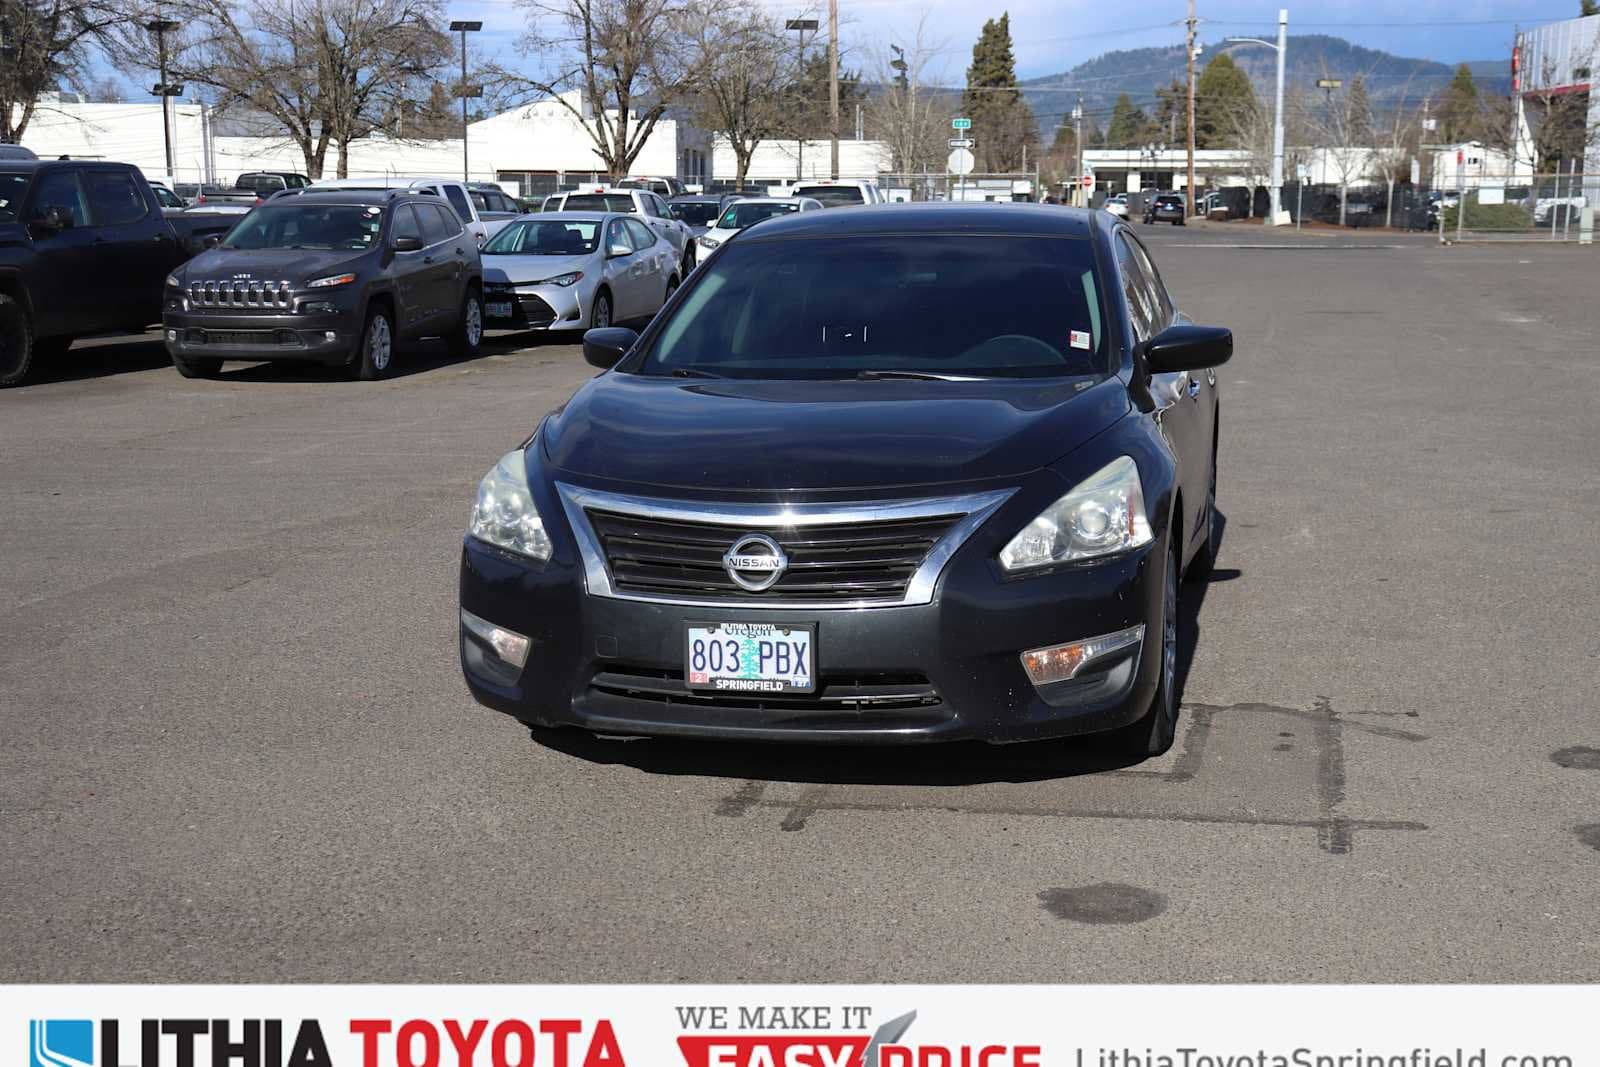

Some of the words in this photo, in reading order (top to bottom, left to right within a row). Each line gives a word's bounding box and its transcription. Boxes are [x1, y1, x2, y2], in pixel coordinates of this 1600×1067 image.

[728, 557, 780, 568] NISSAN
[748, 623, 777, 631] TOYOTA
[692, 639, 740, 673] 803
[758, 640, 807, 676] PBX
[715, 679, 784, 692] SPRINGFIELD
